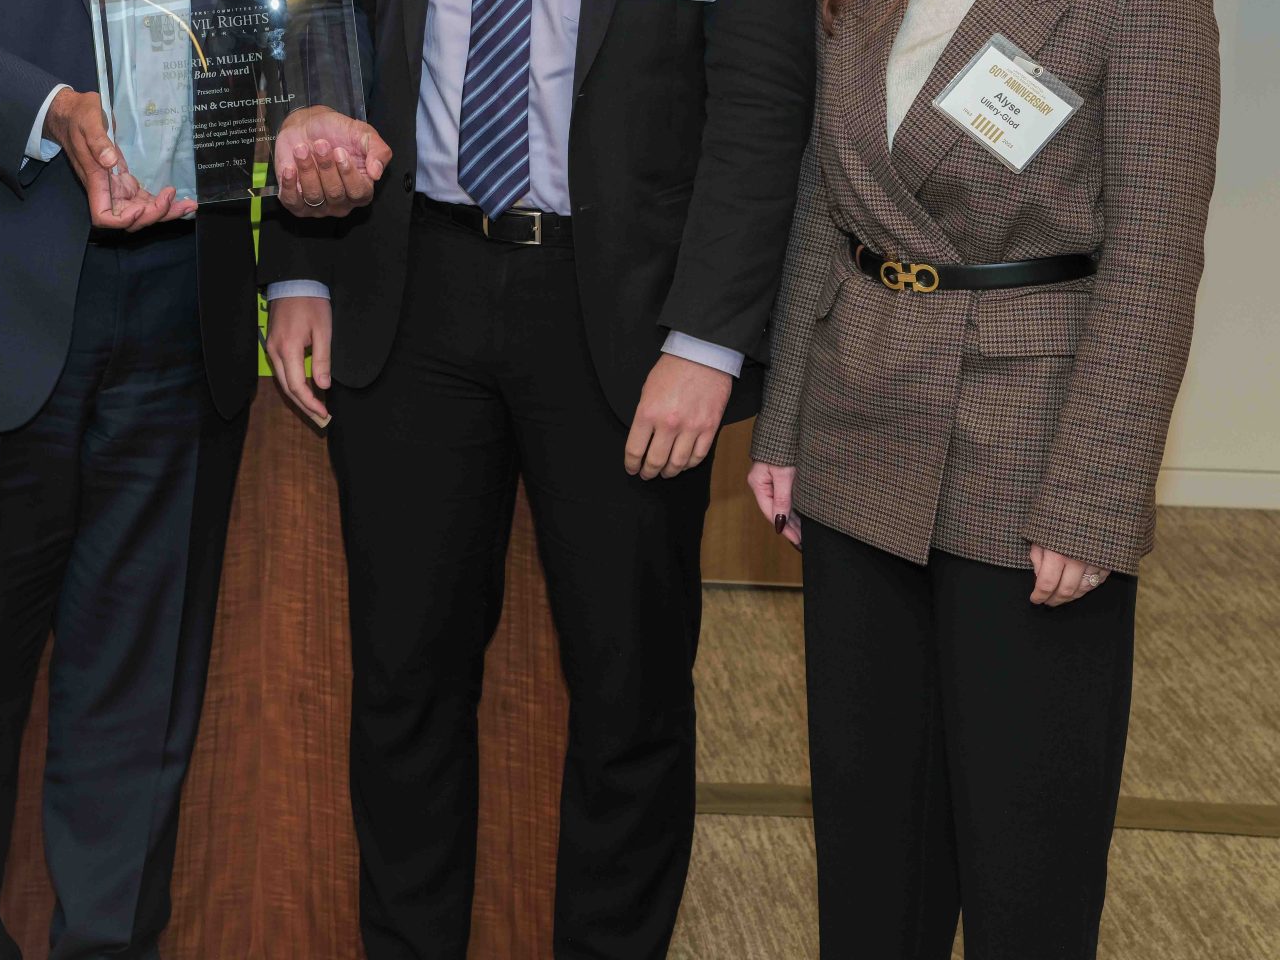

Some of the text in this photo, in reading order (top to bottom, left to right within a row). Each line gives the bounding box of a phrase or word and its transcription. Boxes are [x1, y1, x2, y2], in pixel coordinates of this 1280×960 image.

[217, 12, 270, 29] RIGHTS
[216, 51, 263, 66] MULLEN
[194, 69, 217, 80] Bono
[219, 65, 250, 77] Award
[209, 101, 218, 110] &
[219, 97, 272, 109] CRUTCHER
[274, 93, 296, 104] LLP
[993, 91, 1021, 116] Alyse
[1003, 75, 1054, 117] ANNIVERSARY
[218, 119, 231, 128] legal
[197, 161, 225, 170] December
